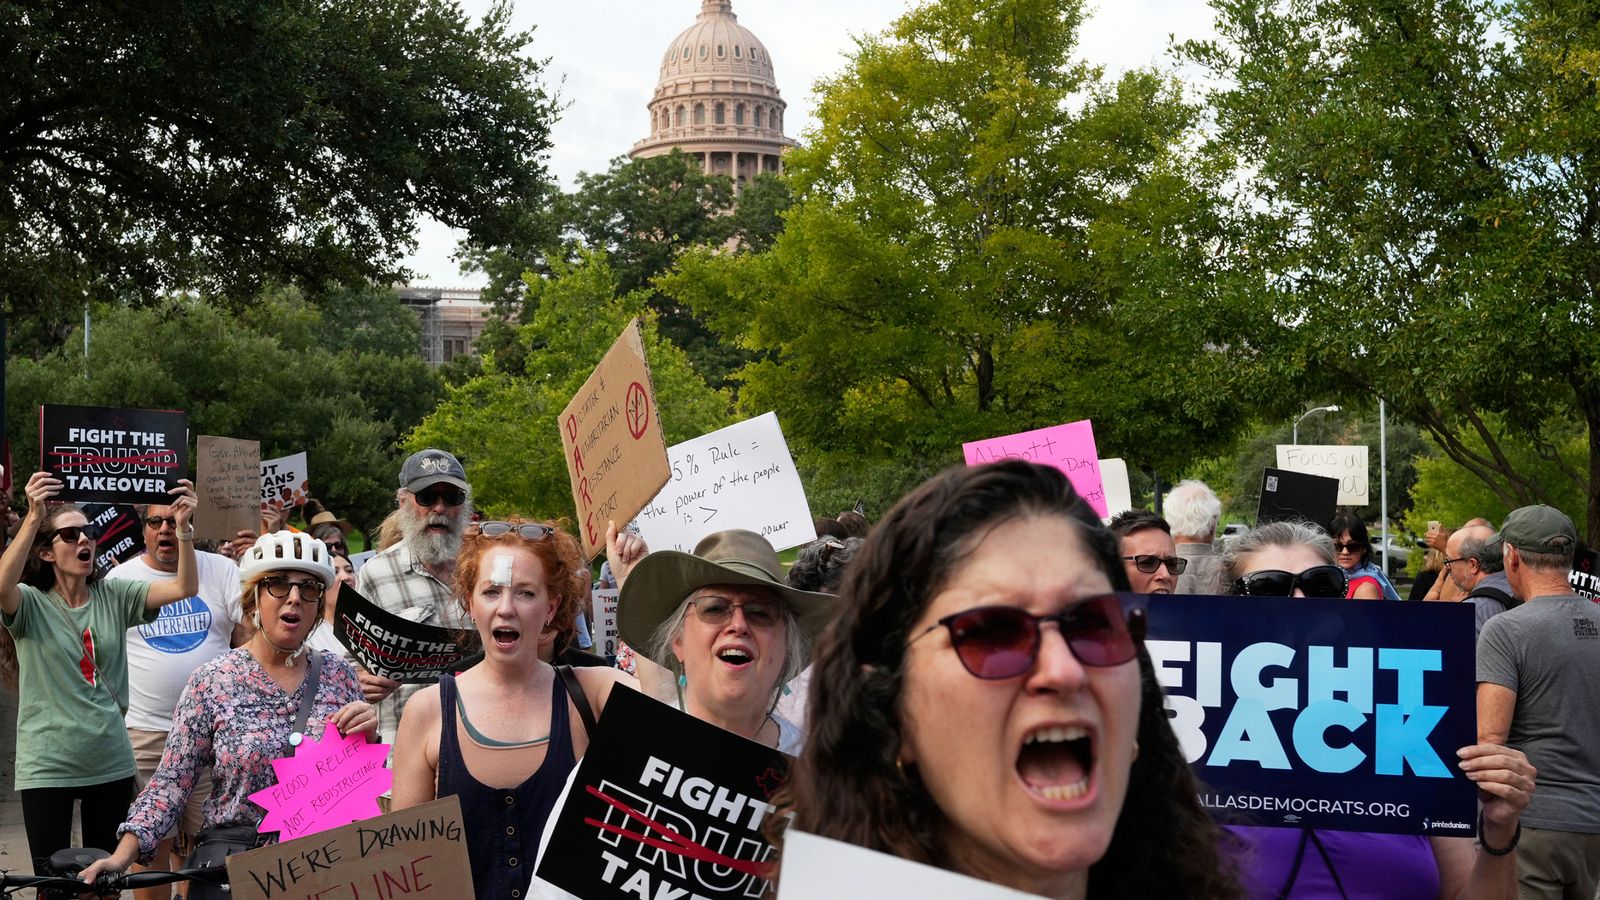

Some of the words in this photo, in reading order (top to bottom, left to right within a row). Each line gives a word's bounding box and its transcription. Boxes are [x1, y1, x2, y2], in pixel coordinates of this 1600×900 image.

[69, 428, 126, 445] FIGHT
[130, 431, 166, 447] THE
[566, 389, 600, 443] DICTATOR
[54, 446, 177, 475] TRUMP
[578, 443, 622, 511] RESISTANCE
[708, 442, 741, 465] Rule
[1060, 457, 1095, 473] Duty
[1286, 448, 1337, 467] FOCUS
[66, 475, 166, 493] TAKEOVER
[643, 502, 667, 519] the
[675, 488, 707, 515] power
[713, 475, 725, 494] of
[729, 469, 749, 487] the
[753, 462, 780, 484] people
[1338, 475, 1366, 496] OD
[95, 506, 118, 526] THE
[585, 490, 618, 546] EFFORT
[683, 512, 693, 525] is
[342, 613, 463, 670] TRUMP
[355, 612, 413, 648] FIGHT
[416, 641, 457, 653] THE
[348, 639, 441, 680] TAKEOVER
[1144, 640, 1443, 715] FIGHT
[1163, 694, 1454, 778] BACK
[272, 774, 309, 807] FLOOD
[315, 740, 361, 777] RELIEF
[283, 807, 306, 836] NOT
[310, 760, 378, 812] REDISTRICTING
[639, 755, 776, 831] FIGHT
[248, 840, 342, 899] WE'RE
[356, 816, 461, 858] DRAWING
[601, 850, 713, 900] TAK
